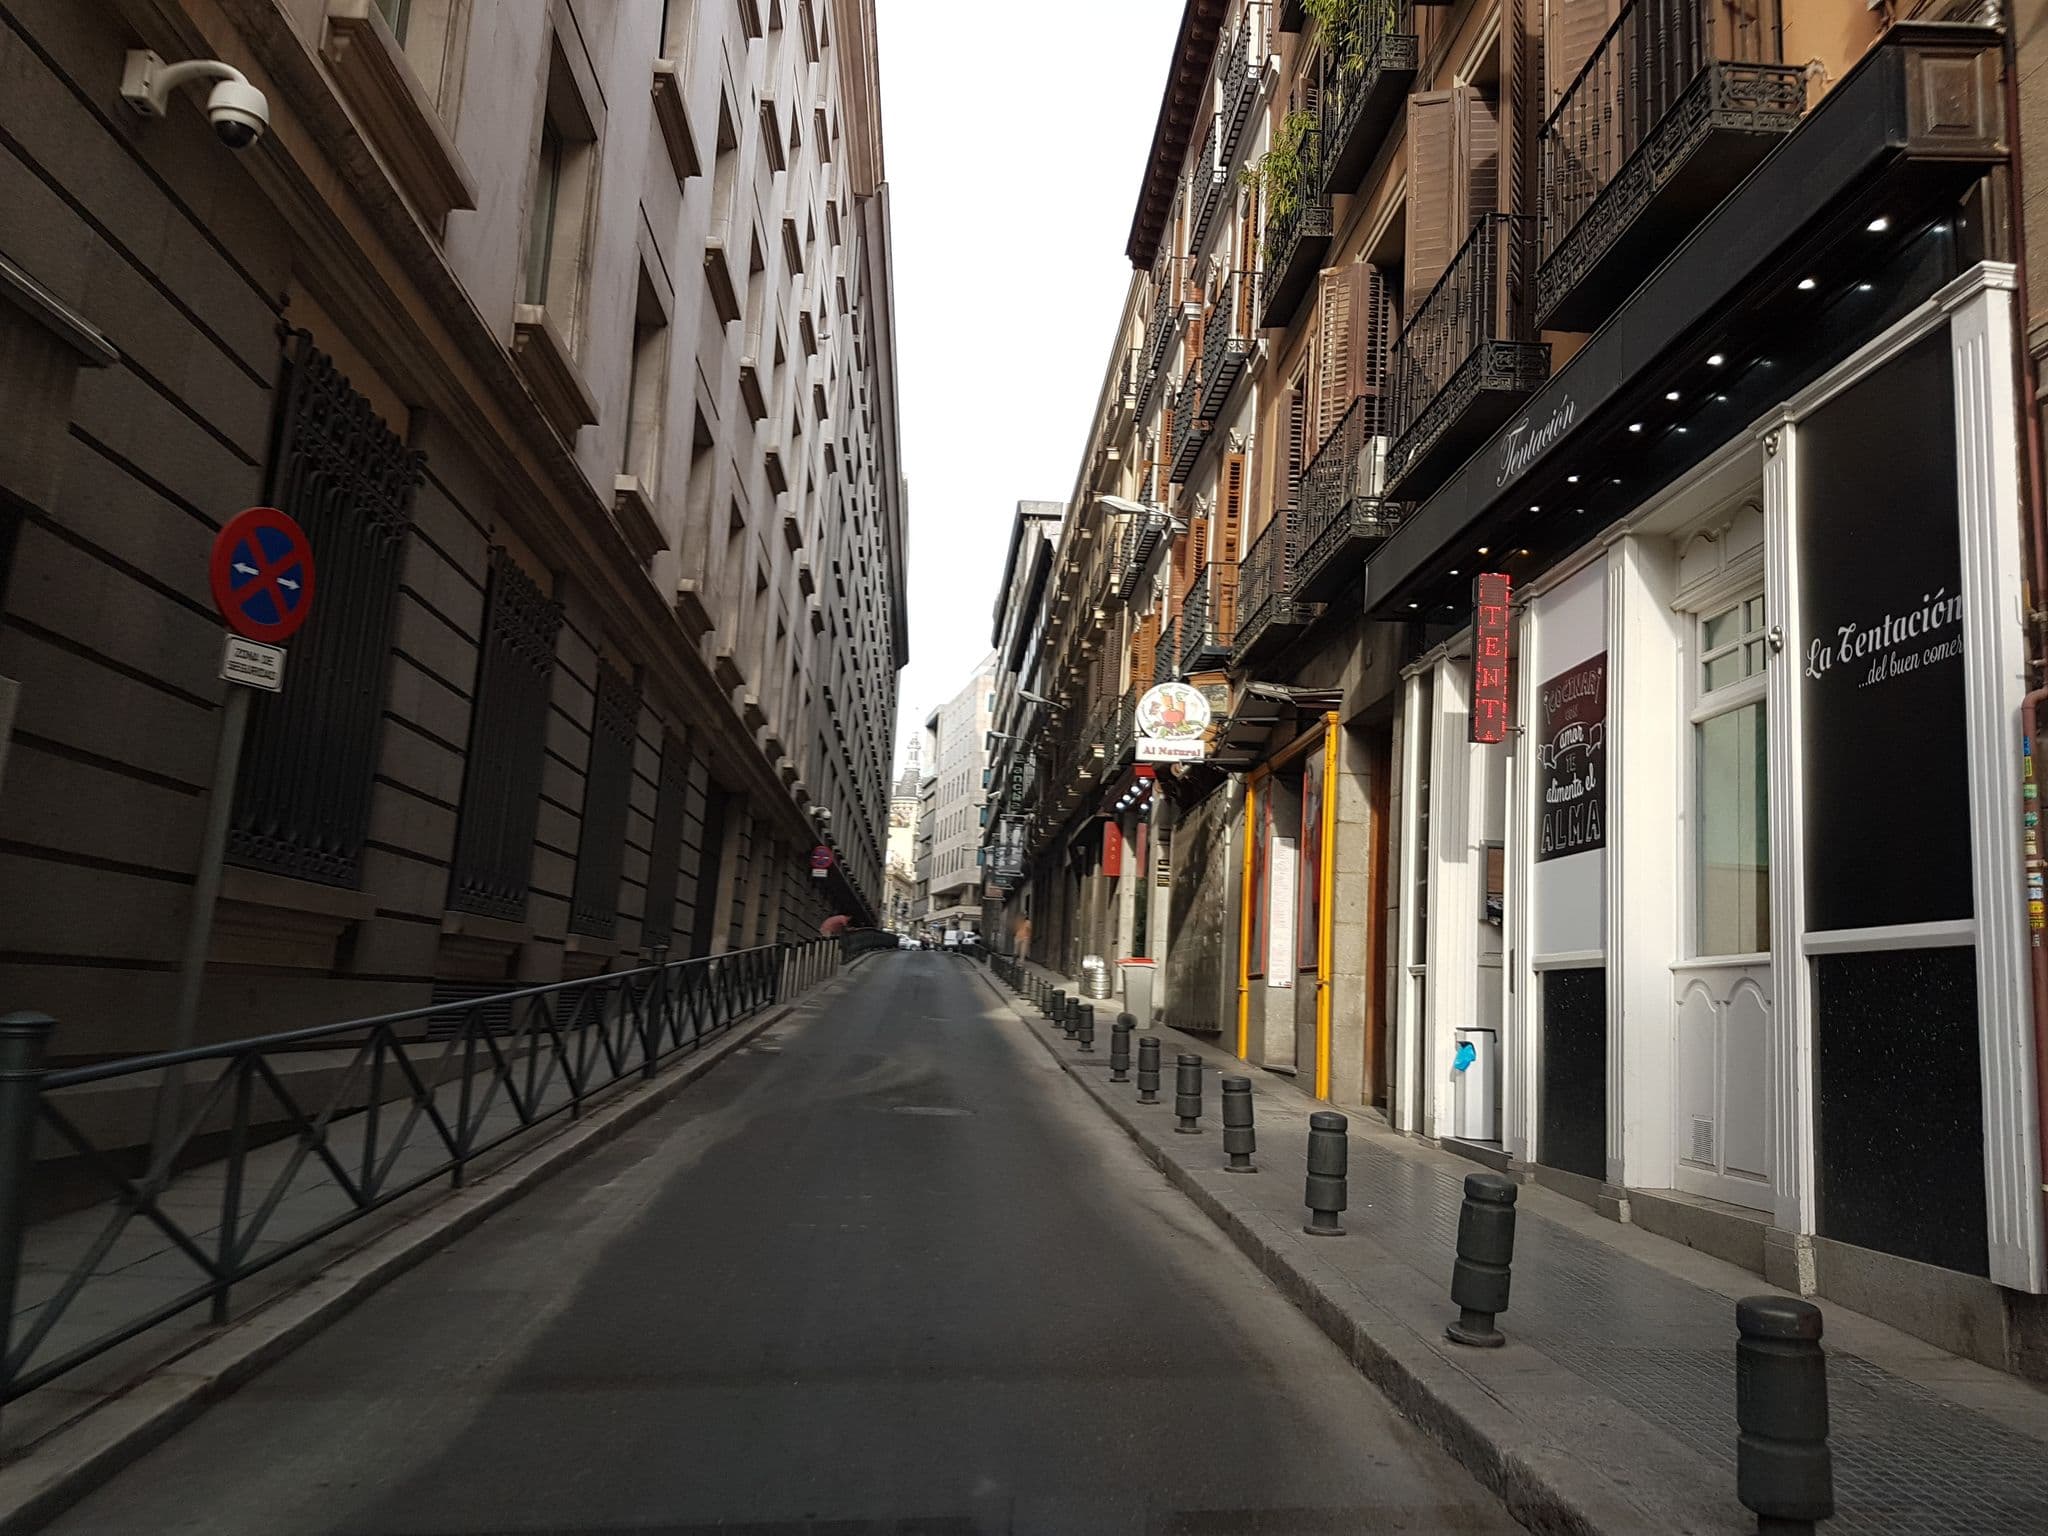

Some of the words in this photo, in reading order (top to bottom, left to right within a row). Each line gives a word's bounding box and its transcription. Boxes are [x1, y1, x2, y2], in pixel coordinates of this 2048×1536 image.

[1496, 394, 1577, 488] Tentación
[1805, 638, 1832, 679] La
[1836, 587, 1963, 663] Tentación
[1890, 651, 1920, 677] buen
[1158, 746, 1201, 757] Natural
[1546, 772, 1584, 803] alimenta
[1585, 762, 1597, 791] el
[1540, 799, 1601, 854] ALMA
